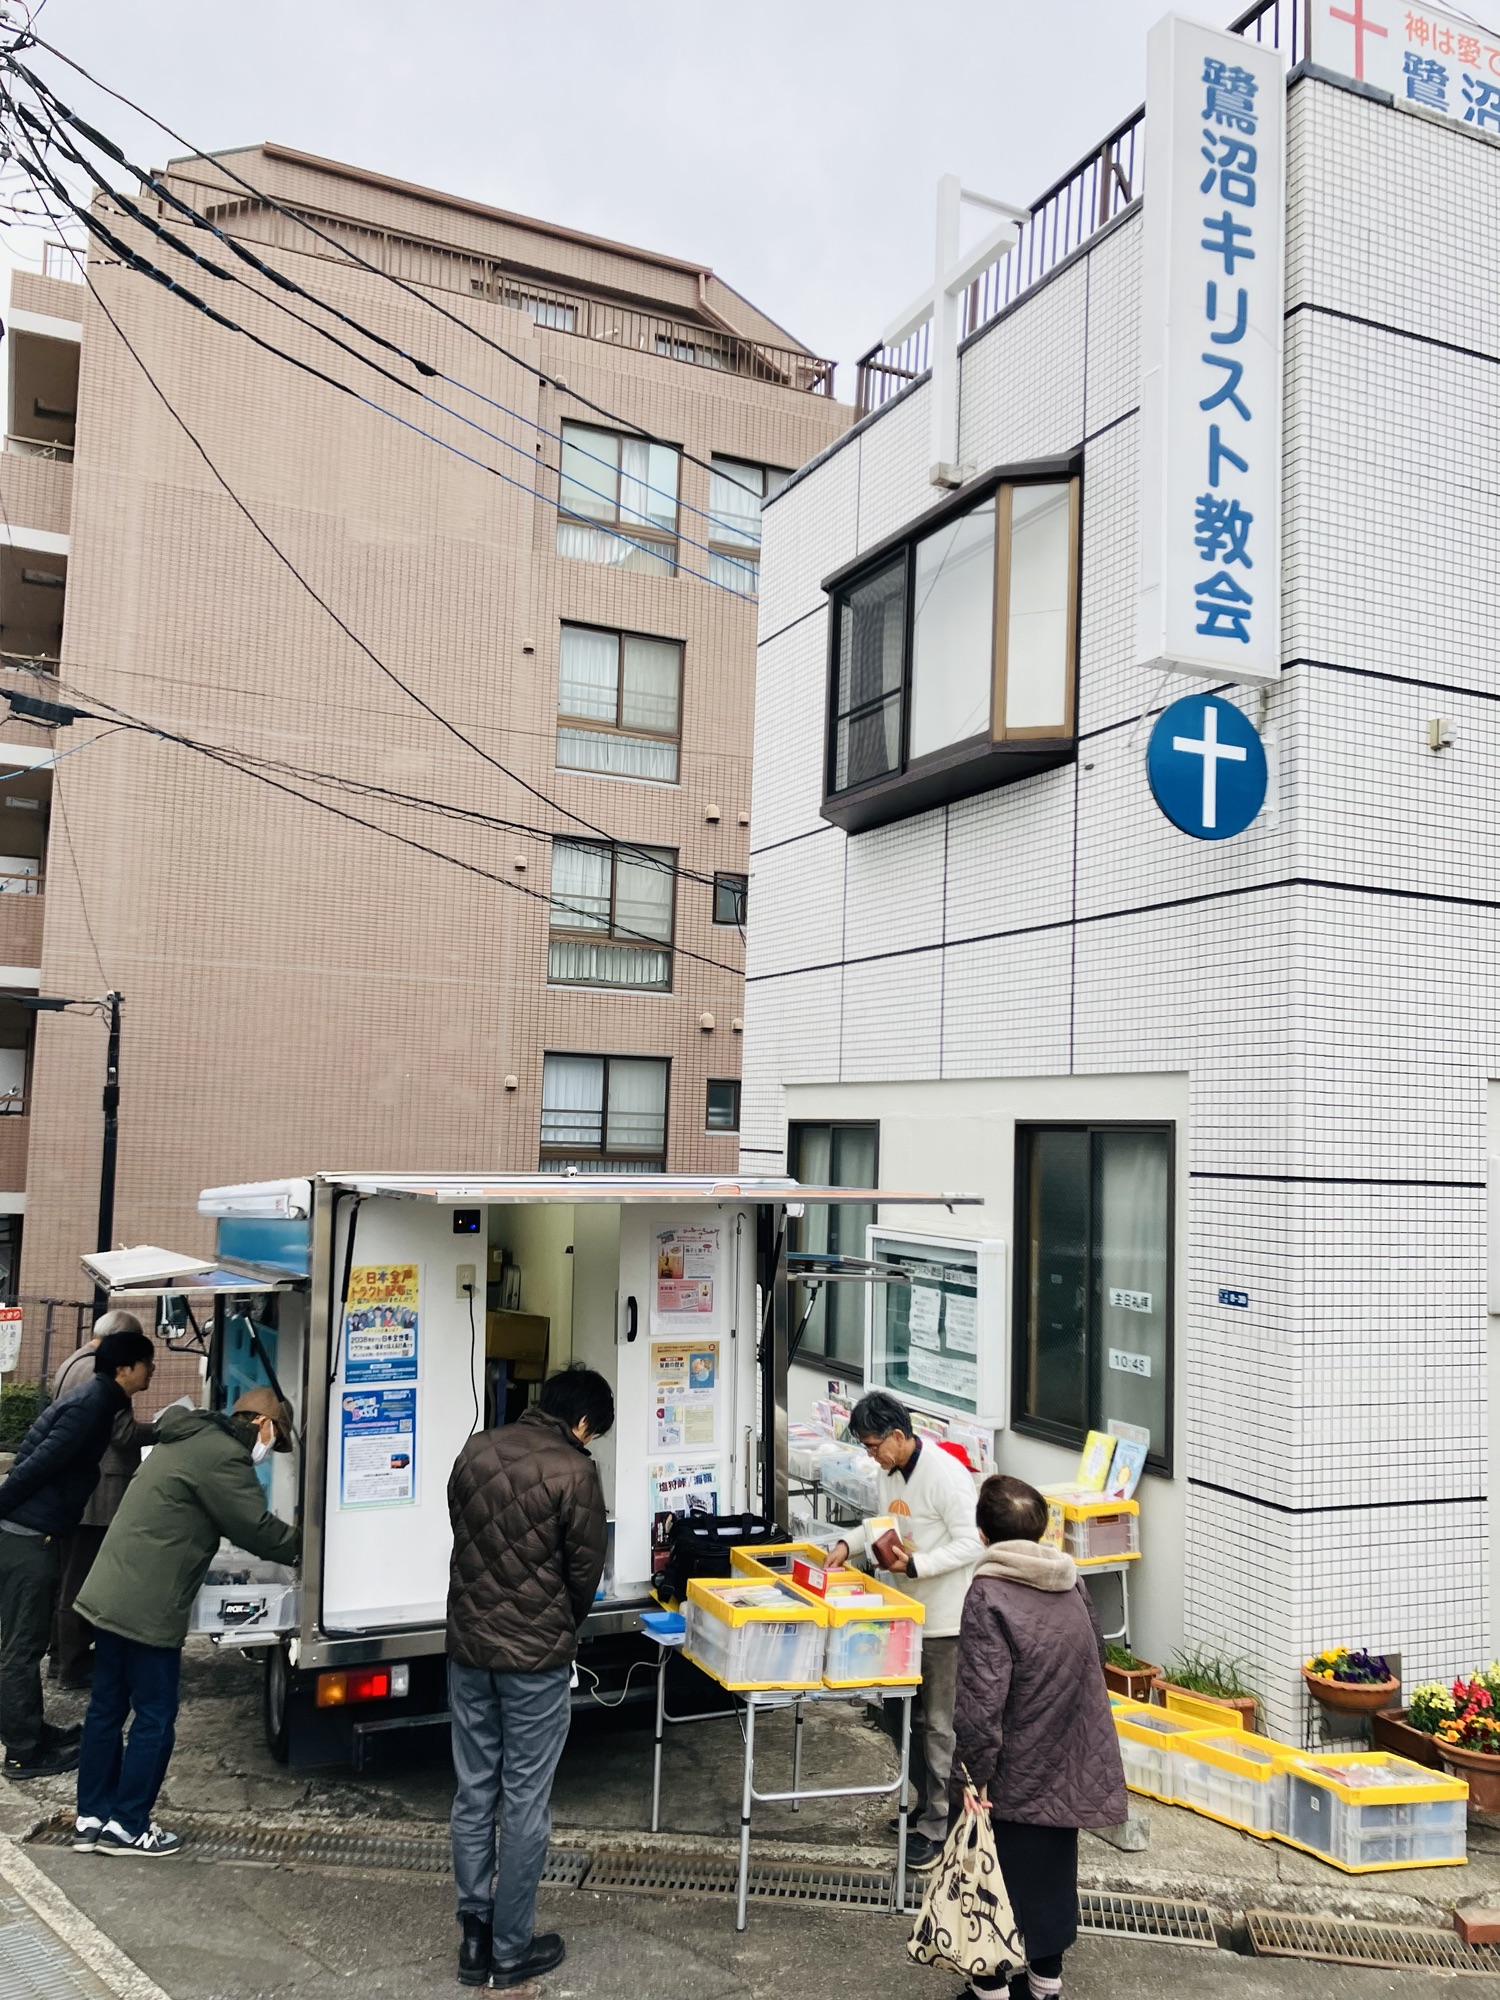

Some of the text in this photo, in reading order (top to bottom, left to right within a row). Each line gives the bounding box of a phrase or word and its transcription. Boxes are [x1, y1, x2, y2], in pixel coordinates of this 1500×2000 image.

[1194, 57, 1259, 645] 鷺沼キリスト教会
[1114, 1292, 1149, 1310] 主日礼拝
[1113, 1354, 1145, 1373] 10:45
